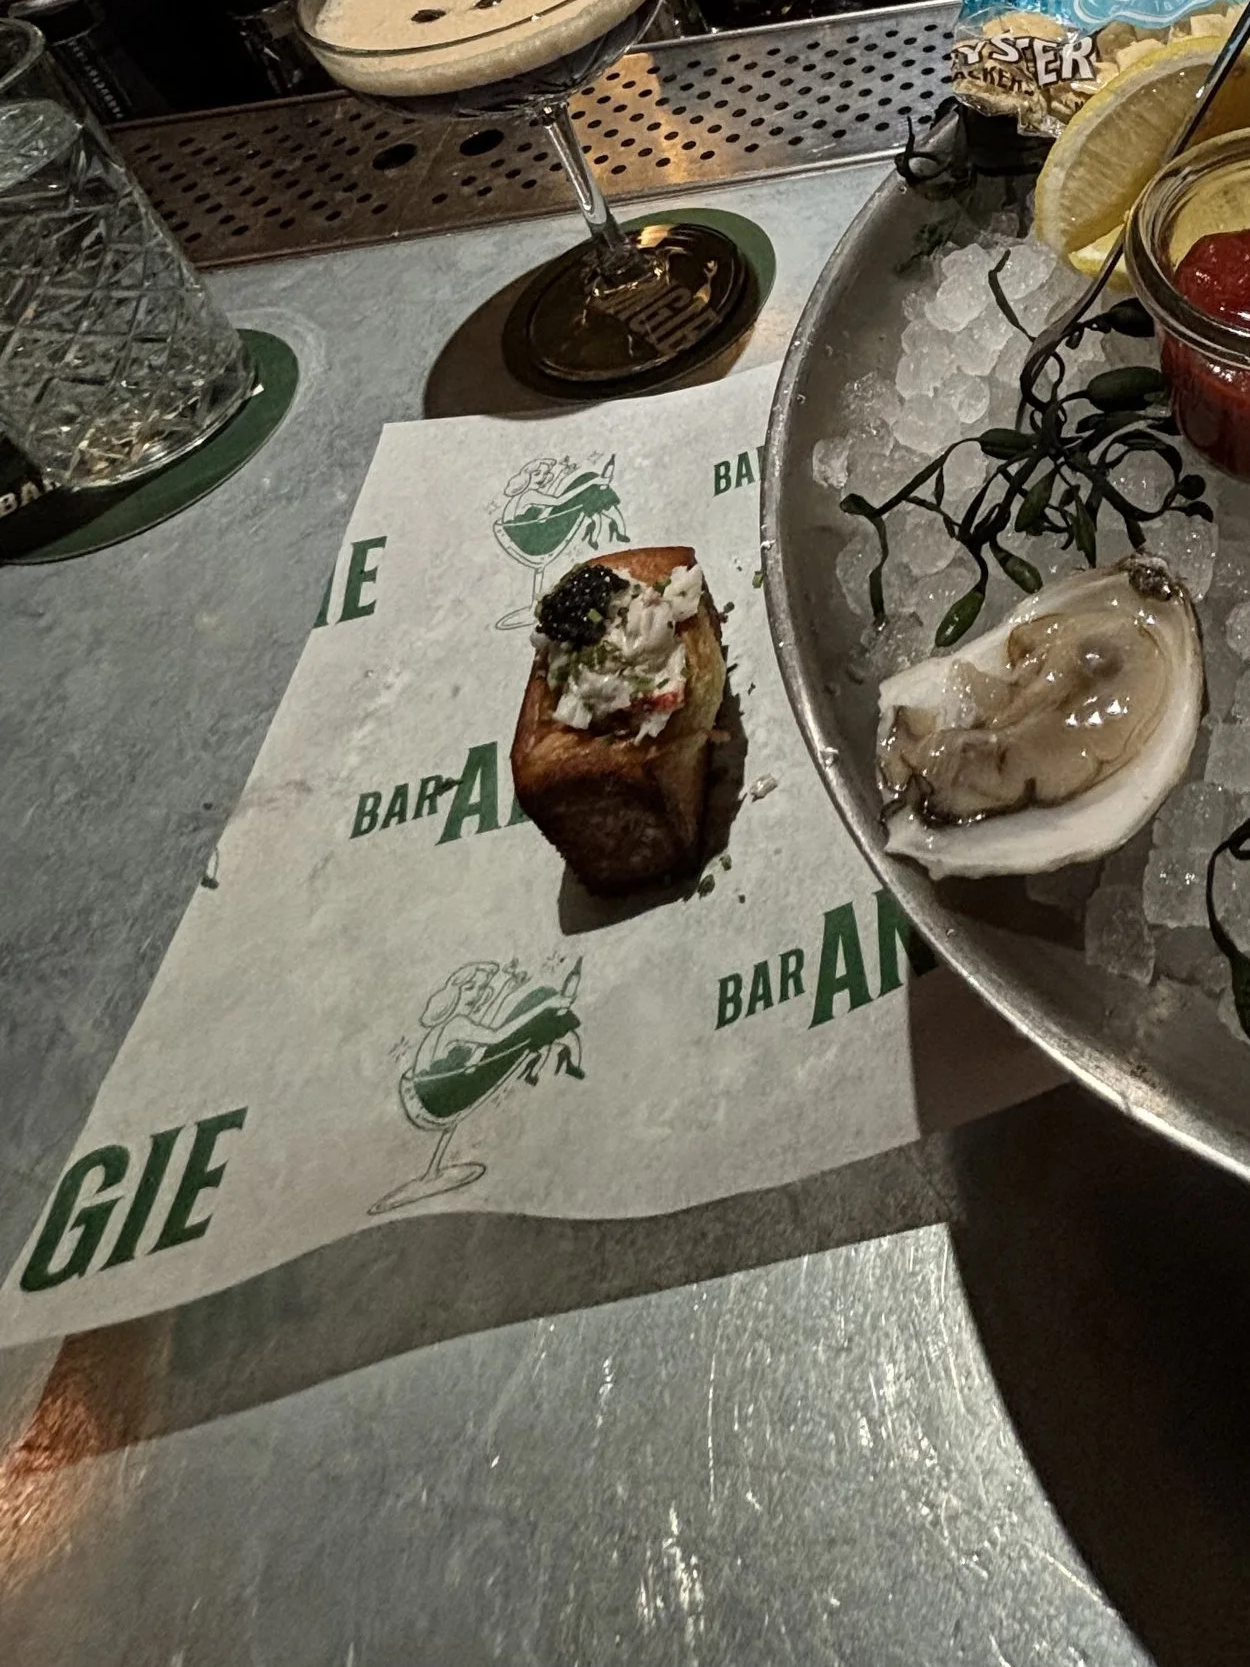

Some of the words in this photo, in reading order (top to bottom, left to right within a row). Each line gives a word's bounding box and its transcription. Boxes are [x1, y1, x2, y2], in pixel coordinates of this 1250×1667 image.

[950, 33, 1095, 87] YSTER
[349, 774, 439, 840] BAR
[714, 947, 806, 1031] BAR
[19, 1105, 249, 1293] GIE
